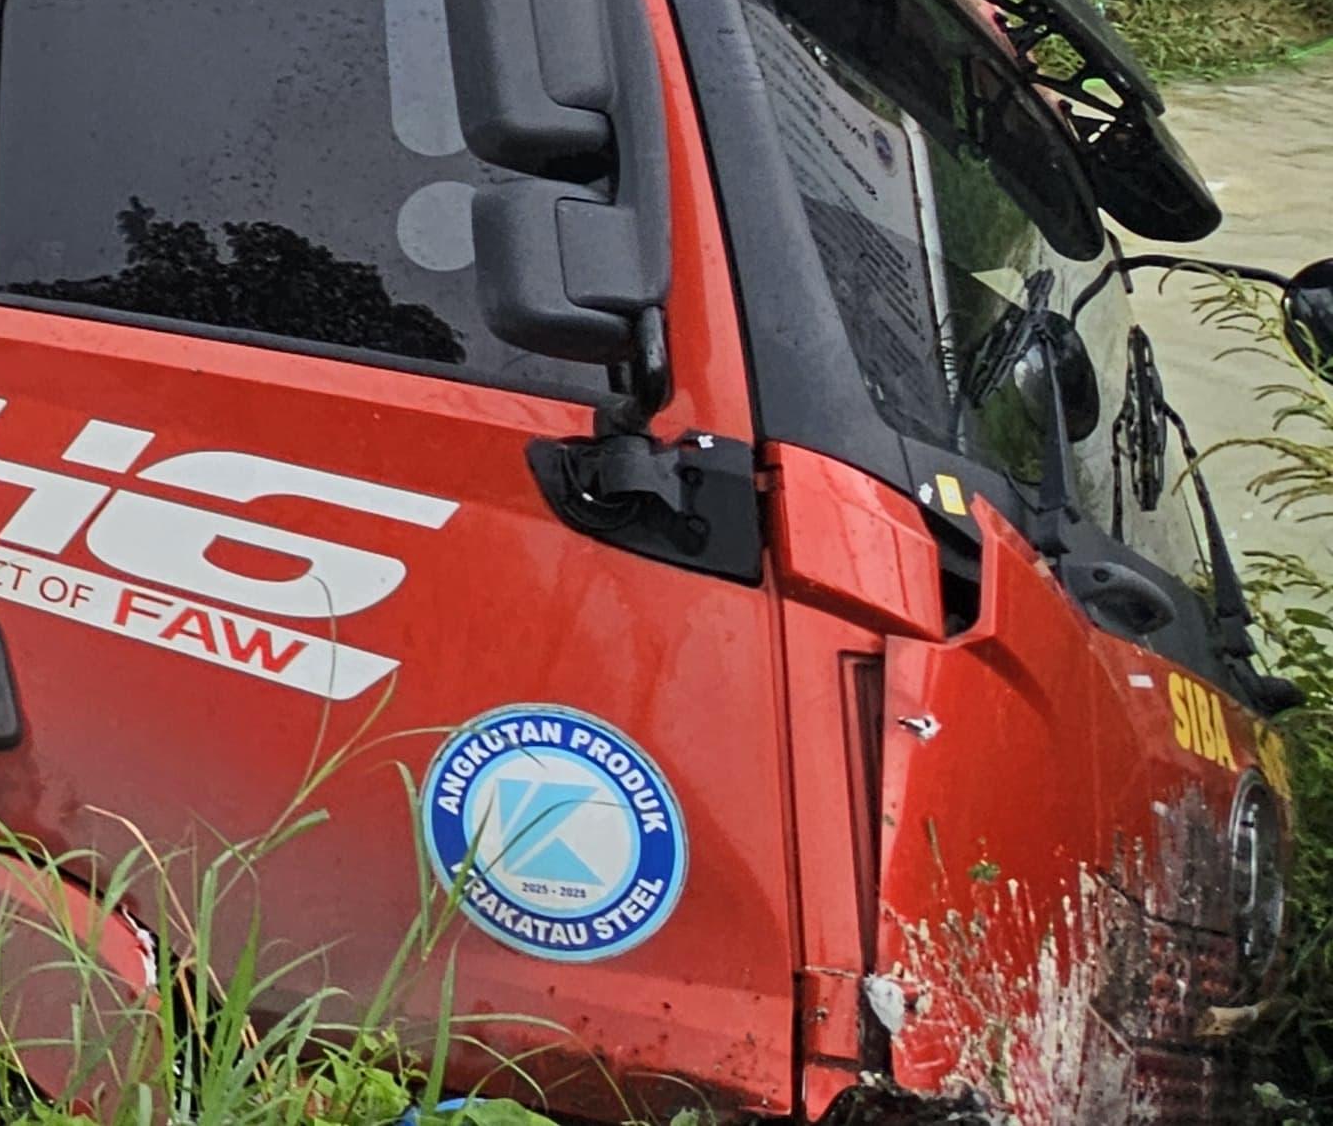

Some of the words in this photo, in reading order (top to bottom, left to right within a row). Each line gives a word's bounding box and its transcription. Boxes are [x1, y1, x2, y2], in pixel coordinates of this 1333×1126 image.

[38, 575, 95, 609] OF
[112, 587, 310, 675] FAW
[1168, 671, 1239, 773] SIBA
[437, 720, 562, 816] ANGKUTAN
[569, 727, 668, 834] PRODUK
[592, 877, 665, 941] STEEL
